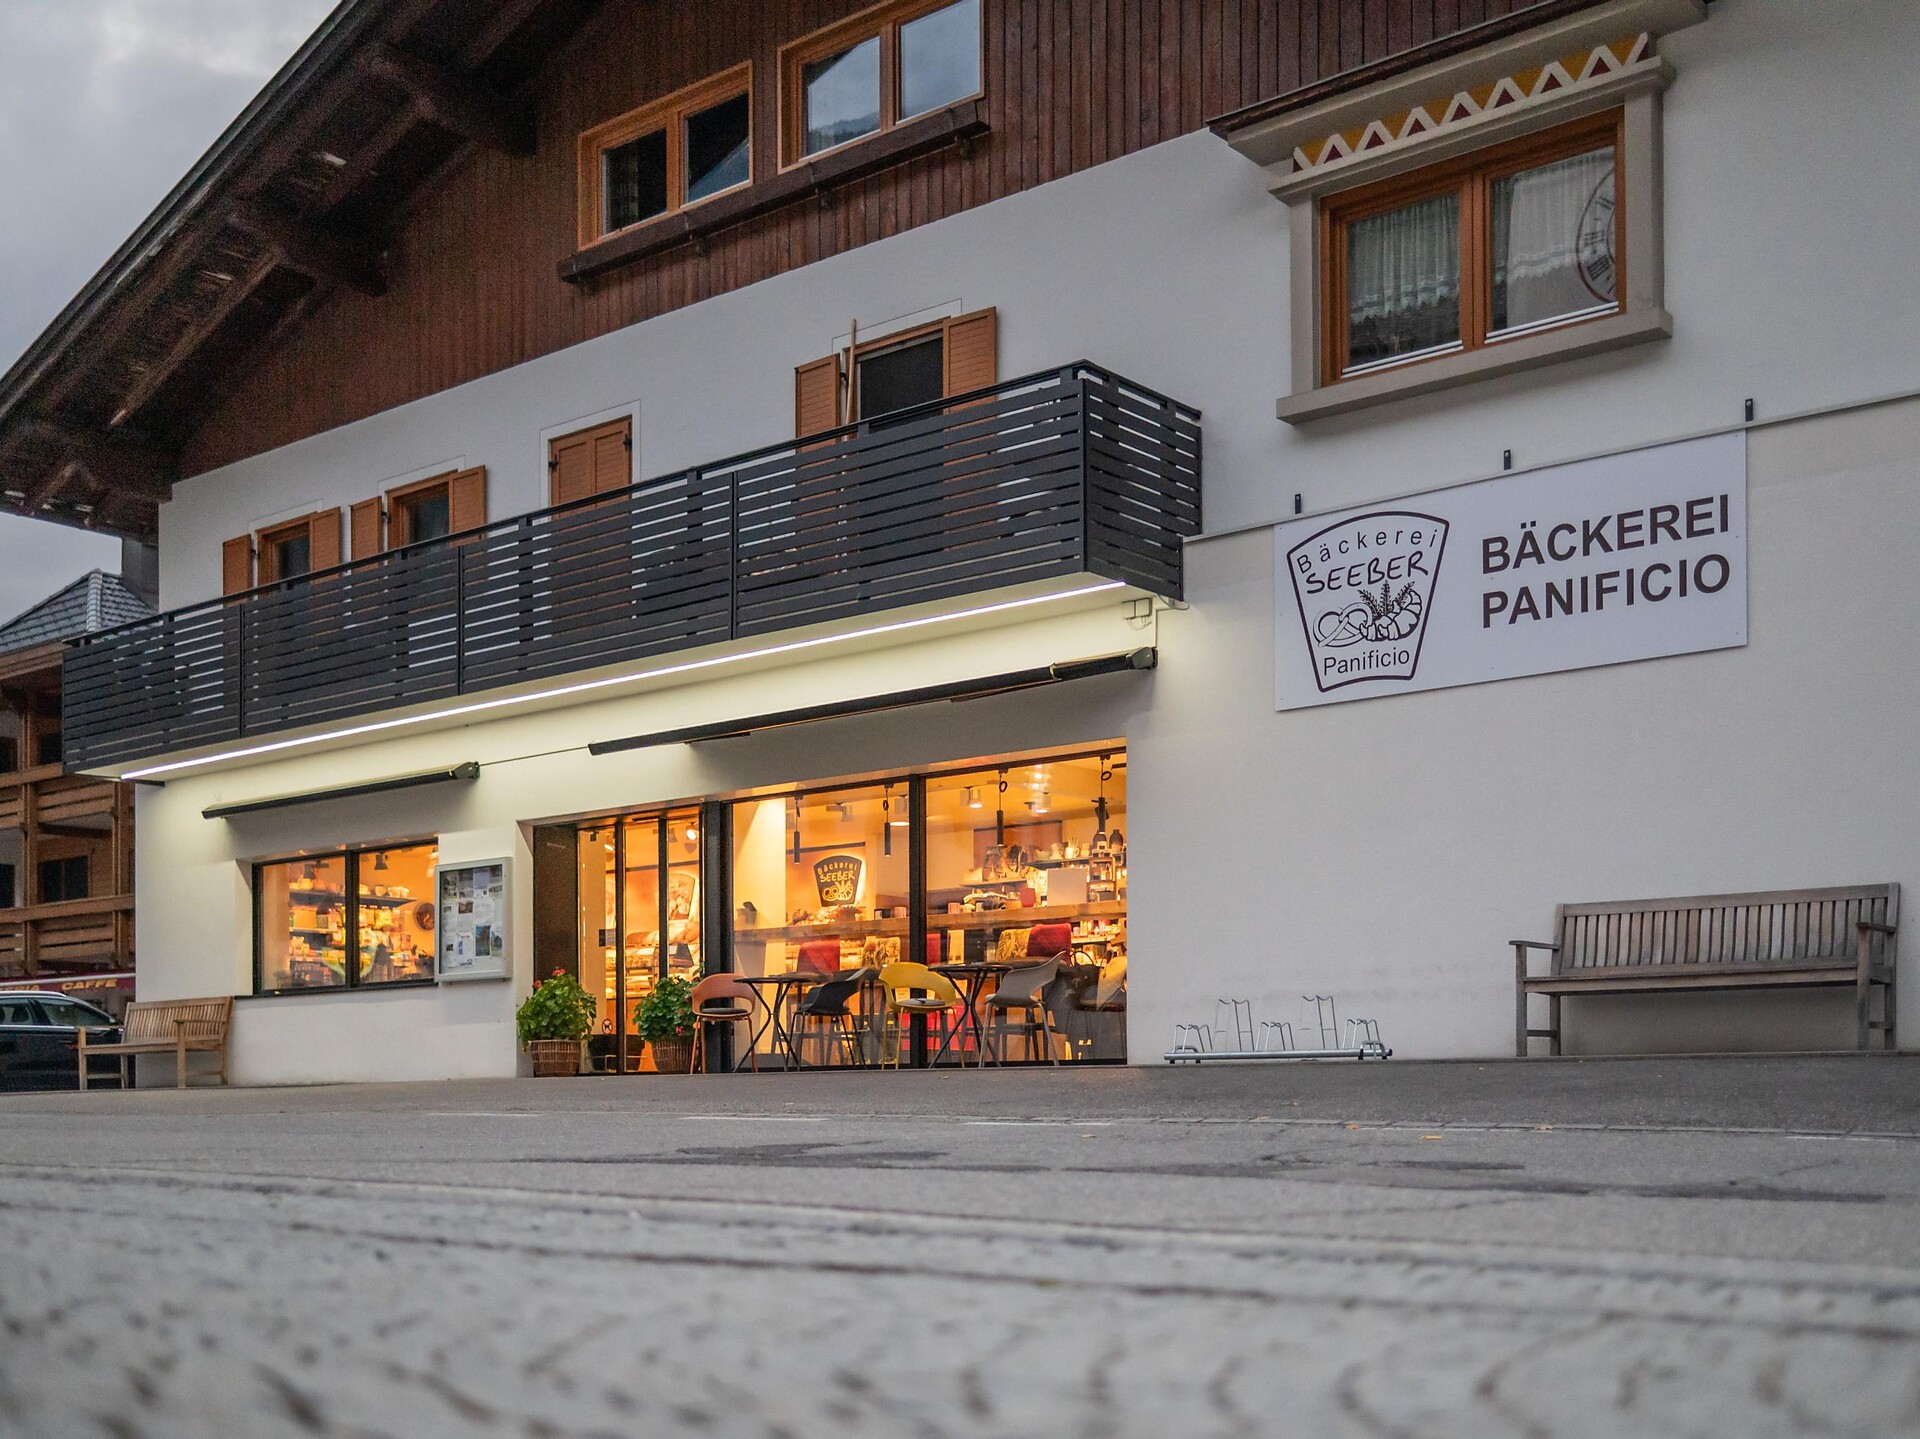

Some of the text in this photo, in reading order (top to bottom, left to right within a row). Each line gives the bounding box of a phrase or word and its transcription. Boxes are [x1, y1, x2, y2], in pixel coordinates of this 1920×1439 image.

[1296, 529, 1438, 574] Bäckerei
[1482, 494, 1729, 574] BÄCKEREI
[1305, 550, 1429, 595] SEEBER
[1482, 553, 1730, 629] PANIFICIO
[1323, 647, 1410, 676] Panificio
[819, 869, 856, 883] SEEBER
